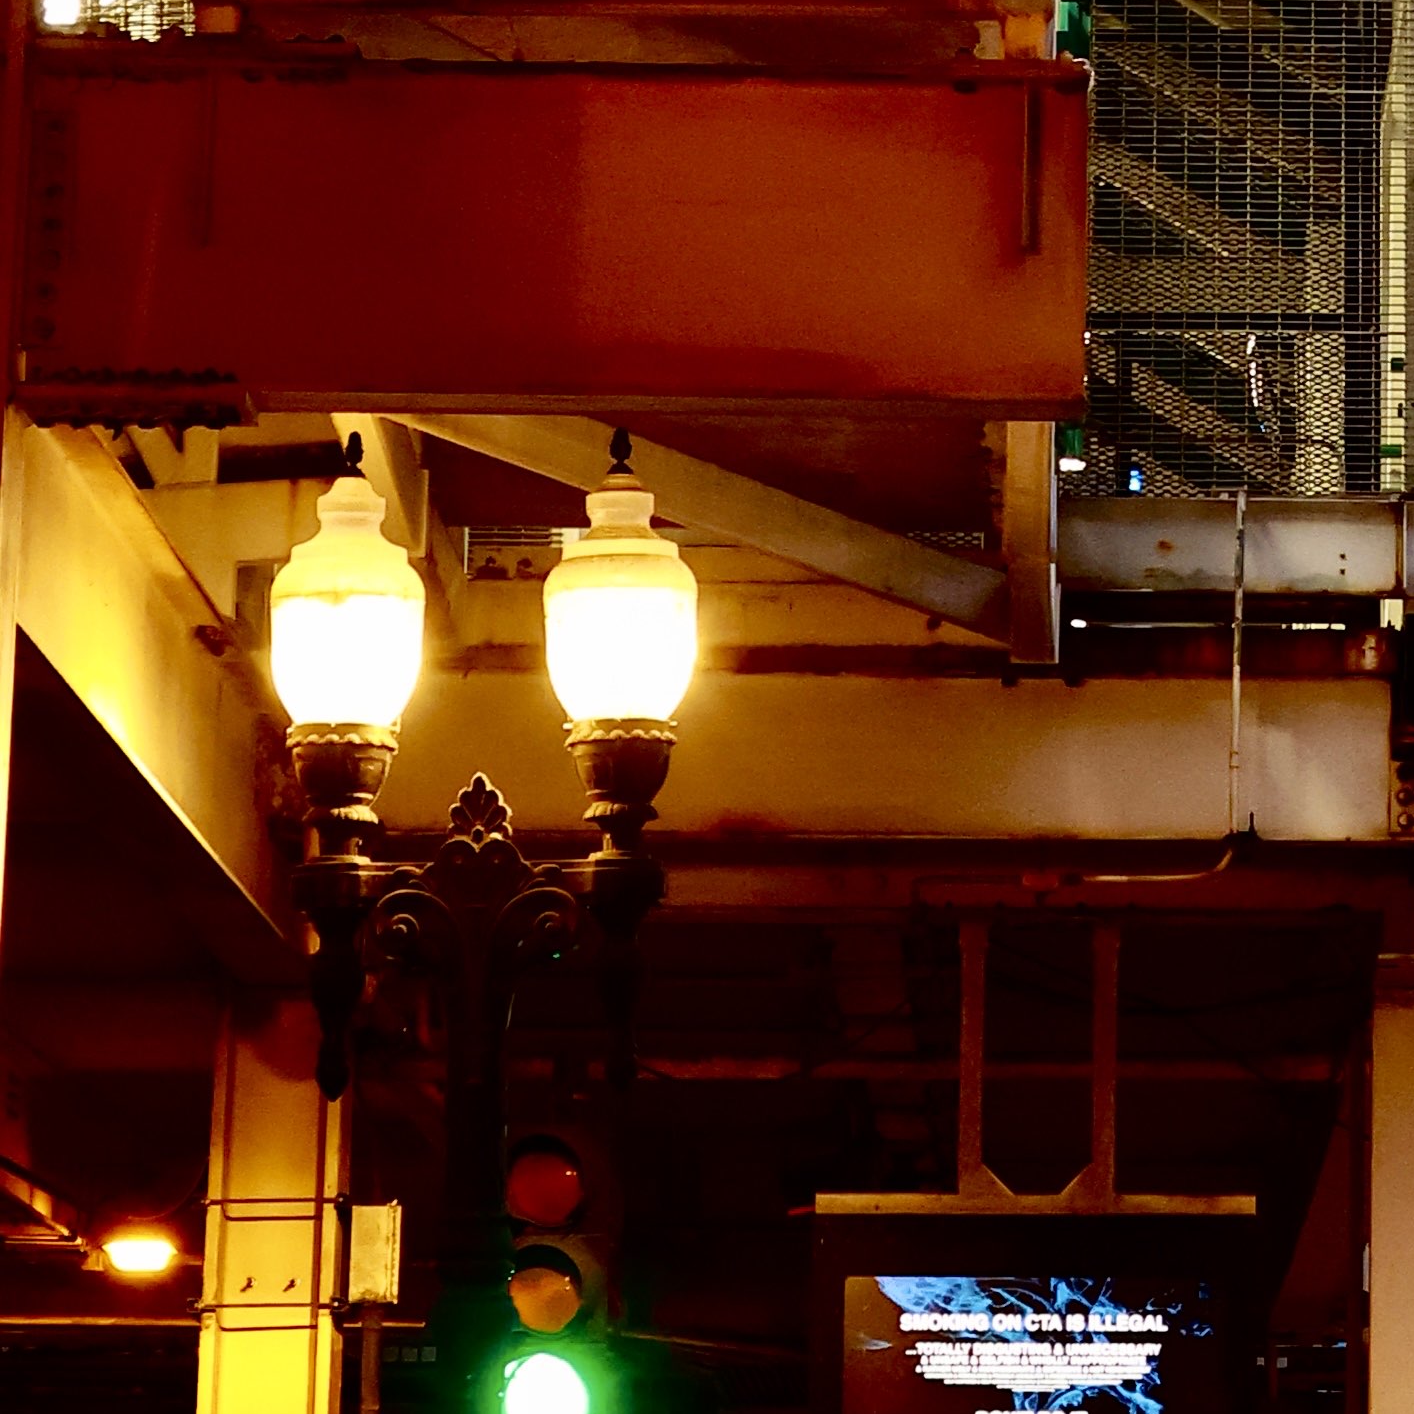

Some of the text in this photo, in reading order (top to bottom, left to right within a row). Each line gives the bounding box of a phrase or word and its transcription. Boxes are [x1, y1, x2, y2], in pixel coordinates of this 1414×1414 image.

[900, 1313, 1169, 1332] SMOKING ON CTA IS ILLEGAL
